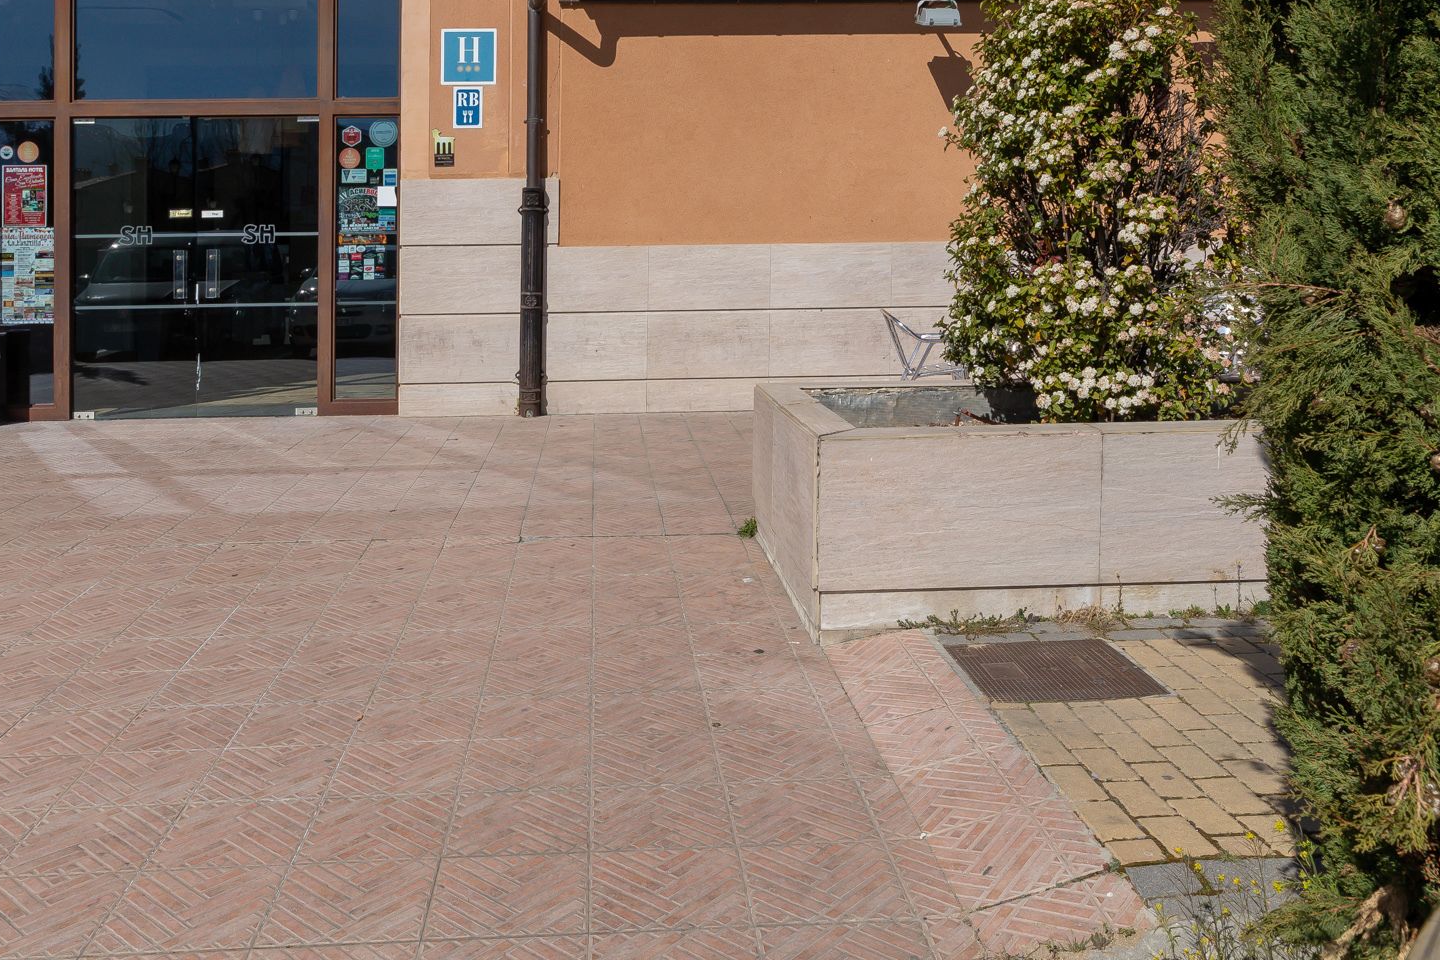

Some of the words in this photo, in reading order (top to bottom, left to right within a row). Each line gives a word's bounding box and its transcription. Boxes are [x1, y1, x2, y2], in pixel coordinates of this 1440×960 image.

[457, 36, 481, 64] H
[457, 91, 479, 107] RB
[119, 225, 152, 245] SH
[241, 224, 275, 244] SH
